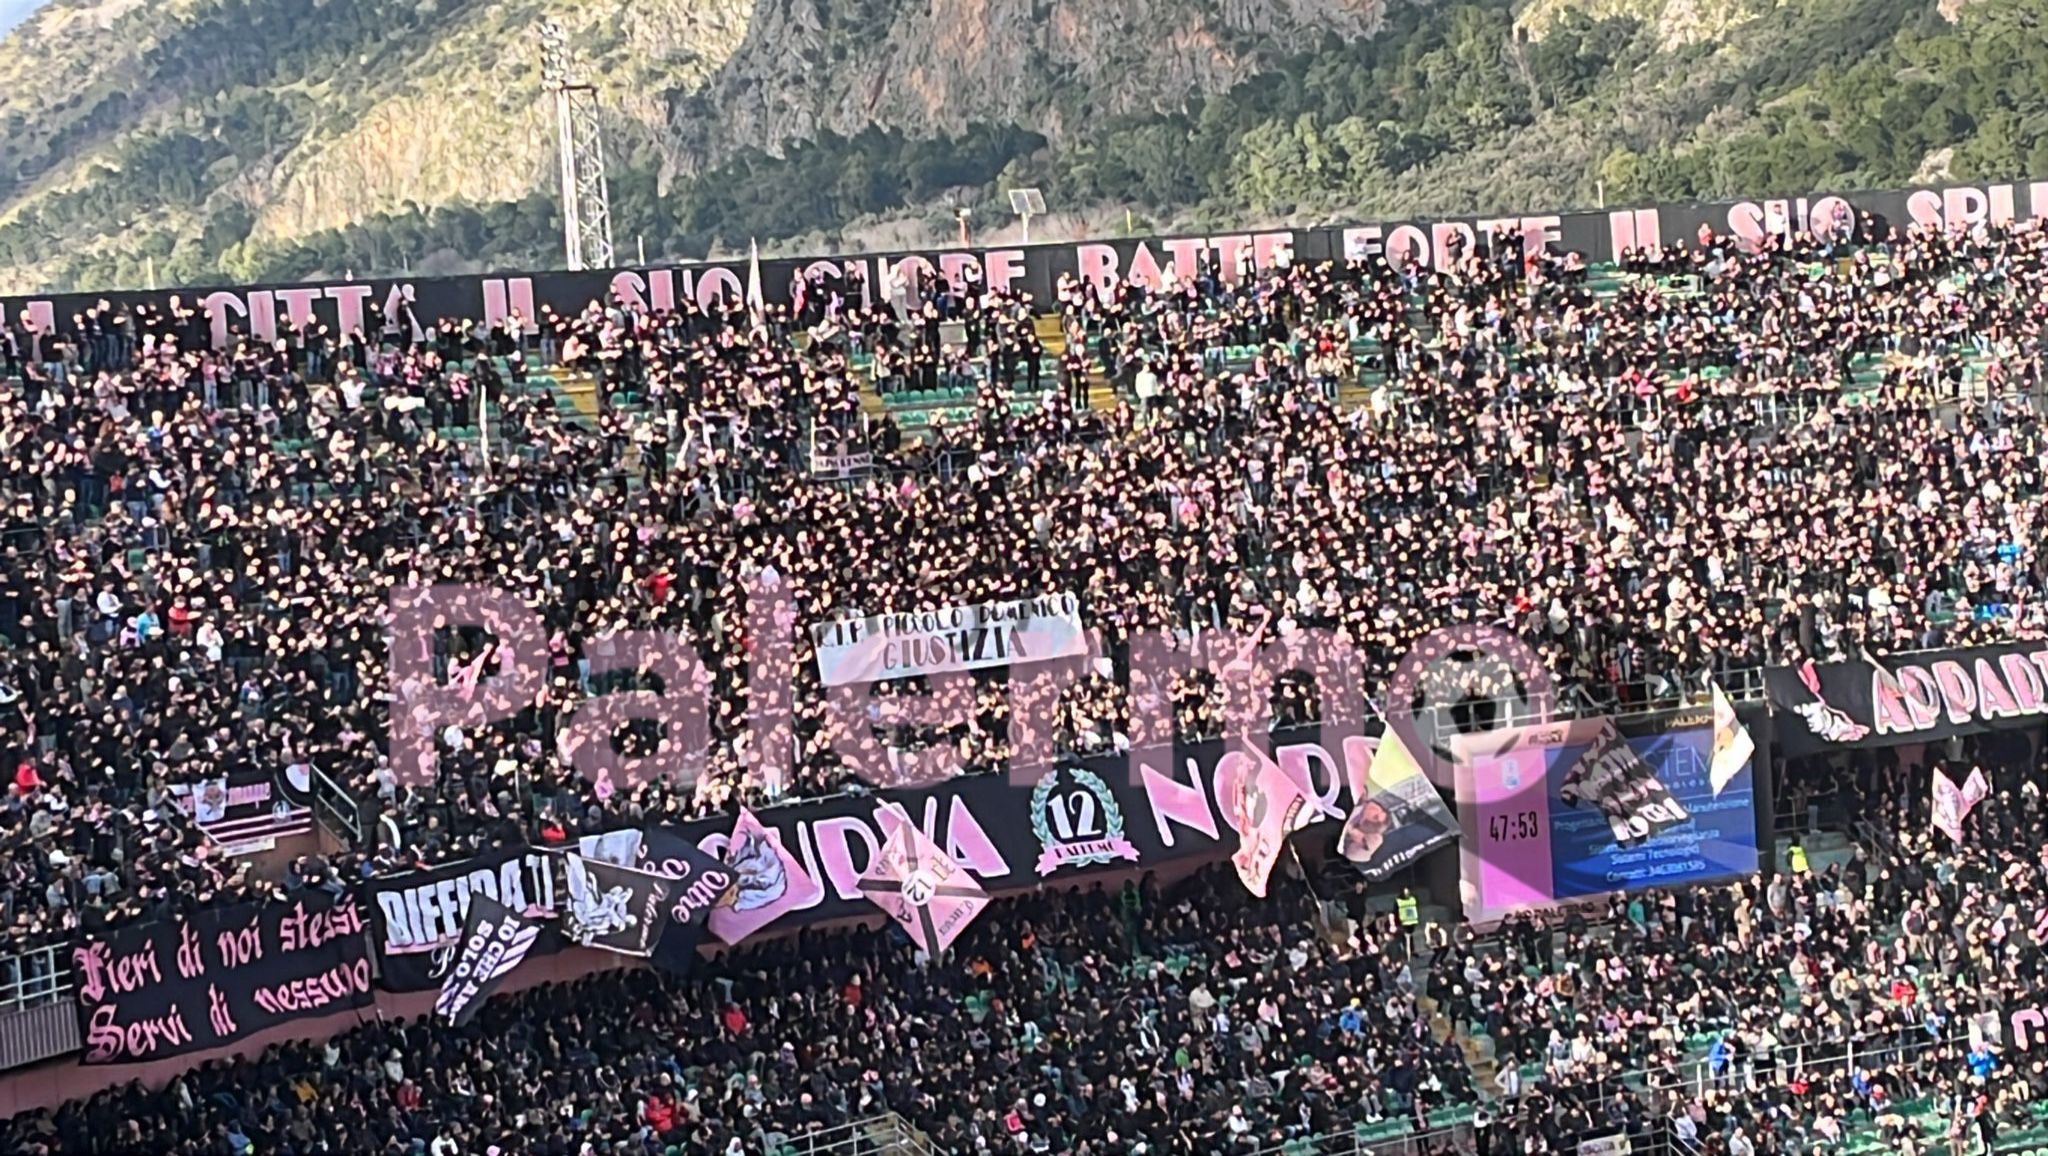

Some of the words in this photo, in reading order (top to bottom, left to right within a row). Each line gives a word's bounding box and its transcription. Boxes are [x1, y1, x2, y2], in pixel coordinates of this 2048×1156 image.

[883, 609, 963, 638] PICCOLO
[883, 625, 1028, 670] GIUSTIZIA
[1047, 789, 1103, 840] 12
[1489, 810, 1539, 842] 47:53
[671, 870, 730, 924] Oltre
[906, 877, 932, 902] 12
[73, 938, 162, 1006] Fieri
[177, 920, 205, 979] di
[217, 915, 263, 969] noi
[280, 893, 364, 953] stessi
[455, 919, 494, 978] SOLO
[498, 915, 520, 941] IO
[472, 940, 505, 983] CHE
[86, 1003, 193, 1064] Servi
[208, 982, 237, 1037] di
